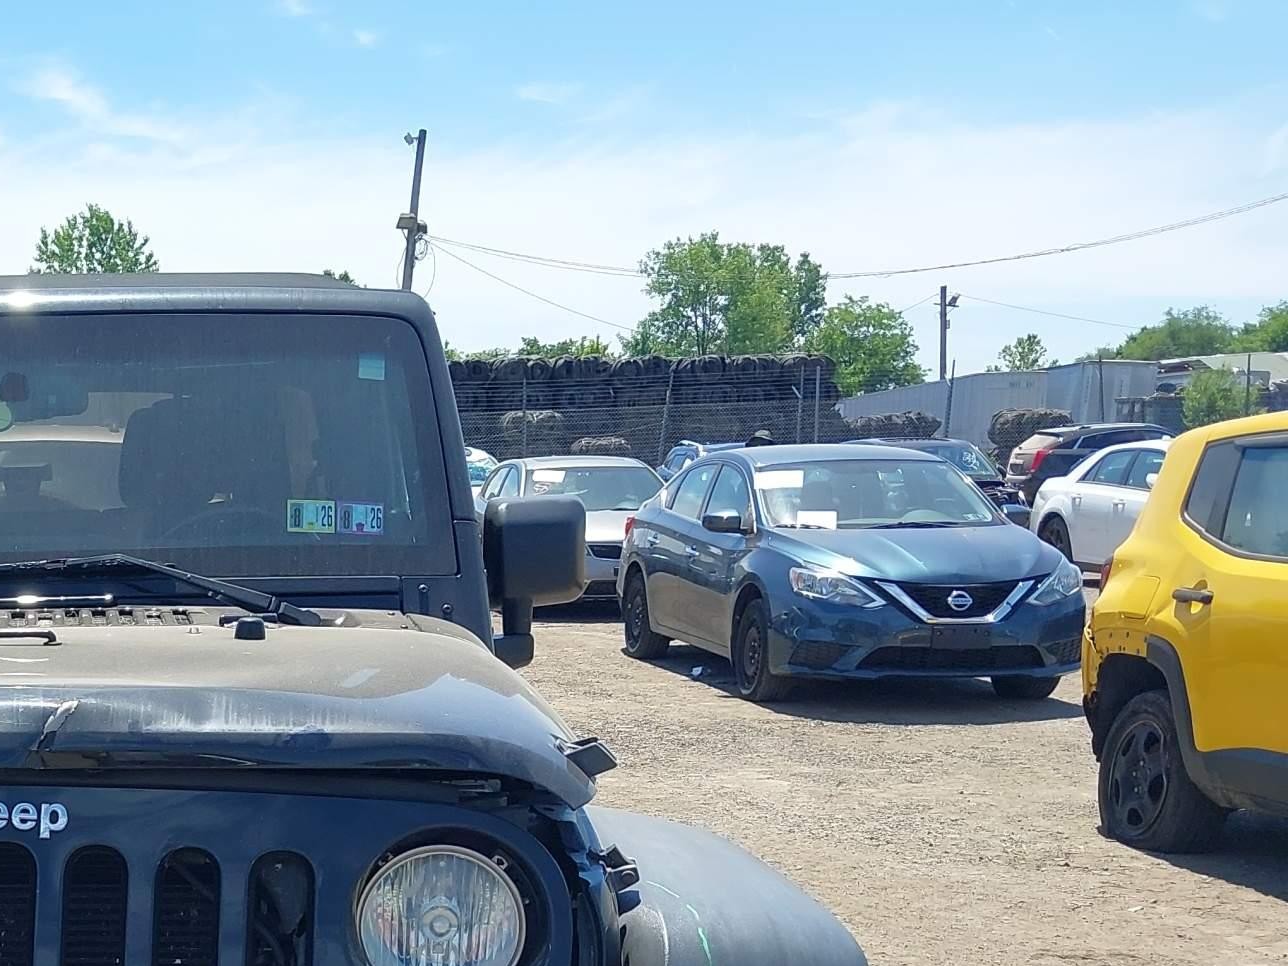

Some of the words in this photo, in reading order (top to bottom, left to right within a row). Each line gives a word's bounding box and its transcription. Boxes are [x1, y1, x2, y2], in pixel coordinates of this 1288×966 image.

[294, 507, 302, 527] 8
[320, 506, 333, 527] 26
[371, 508, 383, 529] 26
